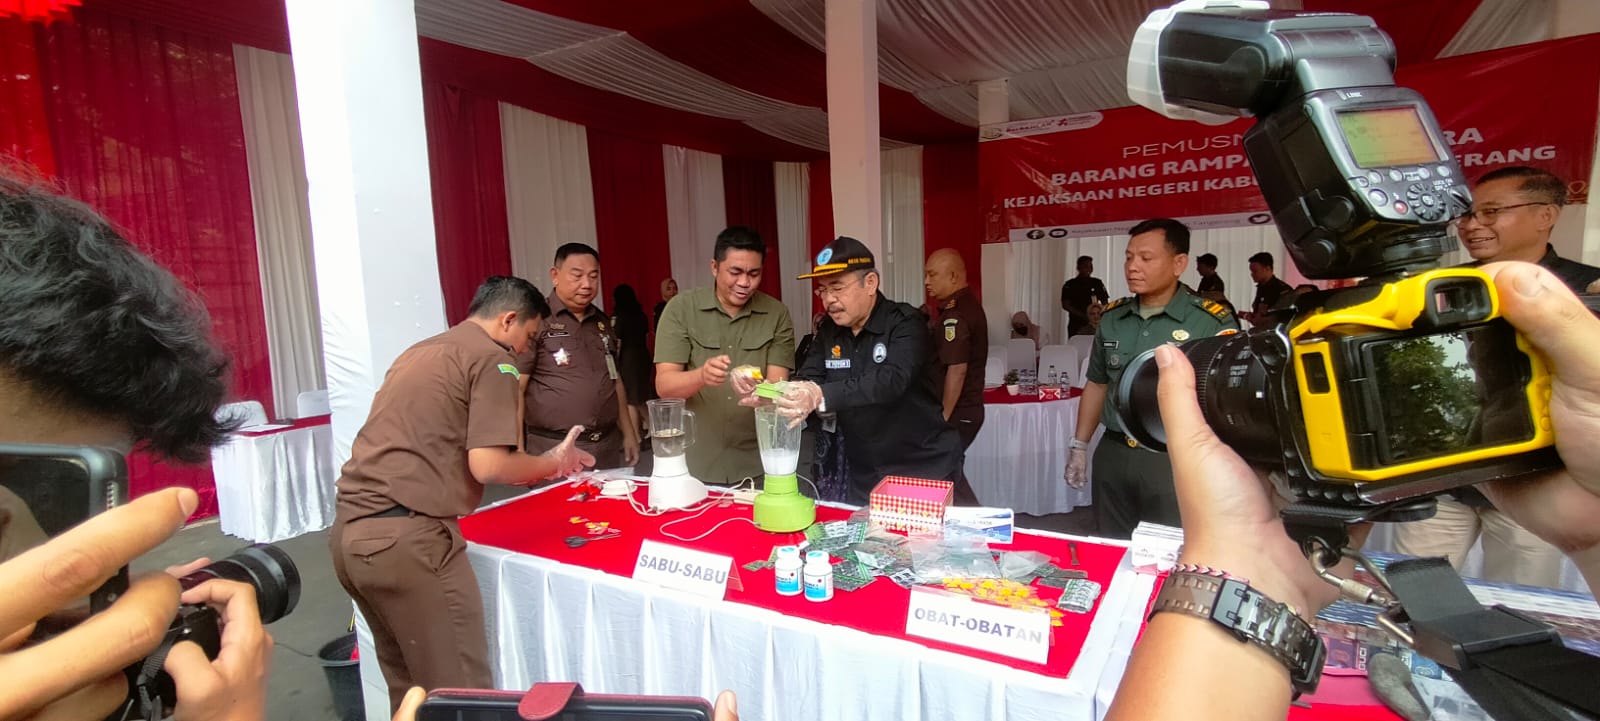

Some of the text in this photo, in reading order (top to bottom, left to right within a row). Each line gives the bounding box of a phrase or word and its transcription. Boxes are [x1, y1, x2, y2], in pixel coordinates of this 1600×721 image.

[1051, 163, 1156, 186] BARANG
[1004, 189, 1113, 209] KEJAKSAAN
[1118, 180, 1199, 199] NEGERI
[639, 552, 727, 586] SABU-SABU
[914, 606, 1042, 645] OBAT-OBATAN
